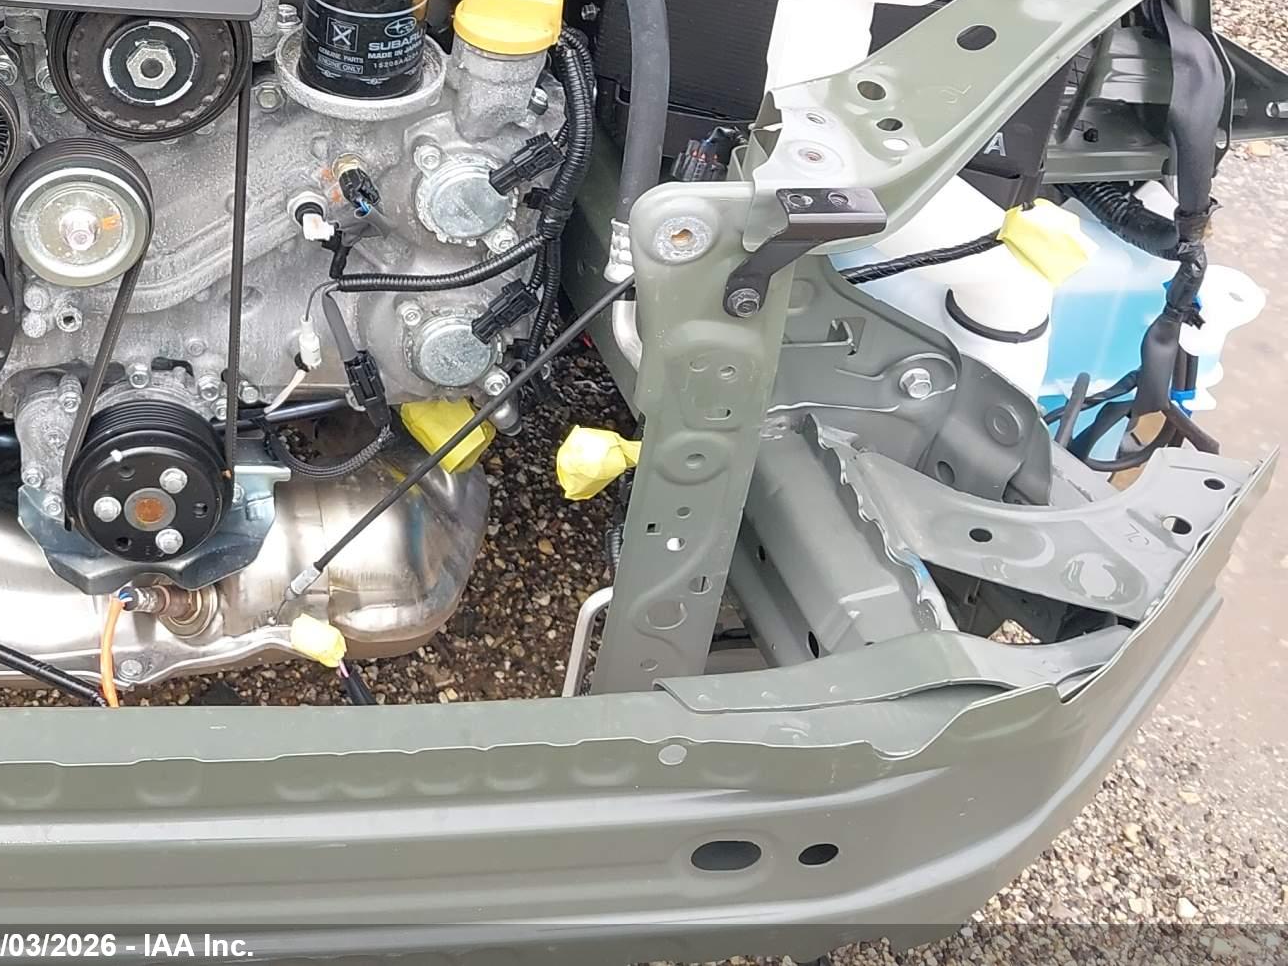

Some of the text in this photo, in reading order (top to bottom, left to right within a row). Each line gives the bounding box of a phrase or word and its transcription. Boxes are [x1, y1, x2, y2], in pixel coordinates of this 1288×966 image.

[368, 29, 423, 51] SUBARU
[343, 54, 364, 64] PARTS
[367, 50, 393, 60] MADE
[394, 48, 404, 57] IN
[342, 64, 363, 73] ONLY
